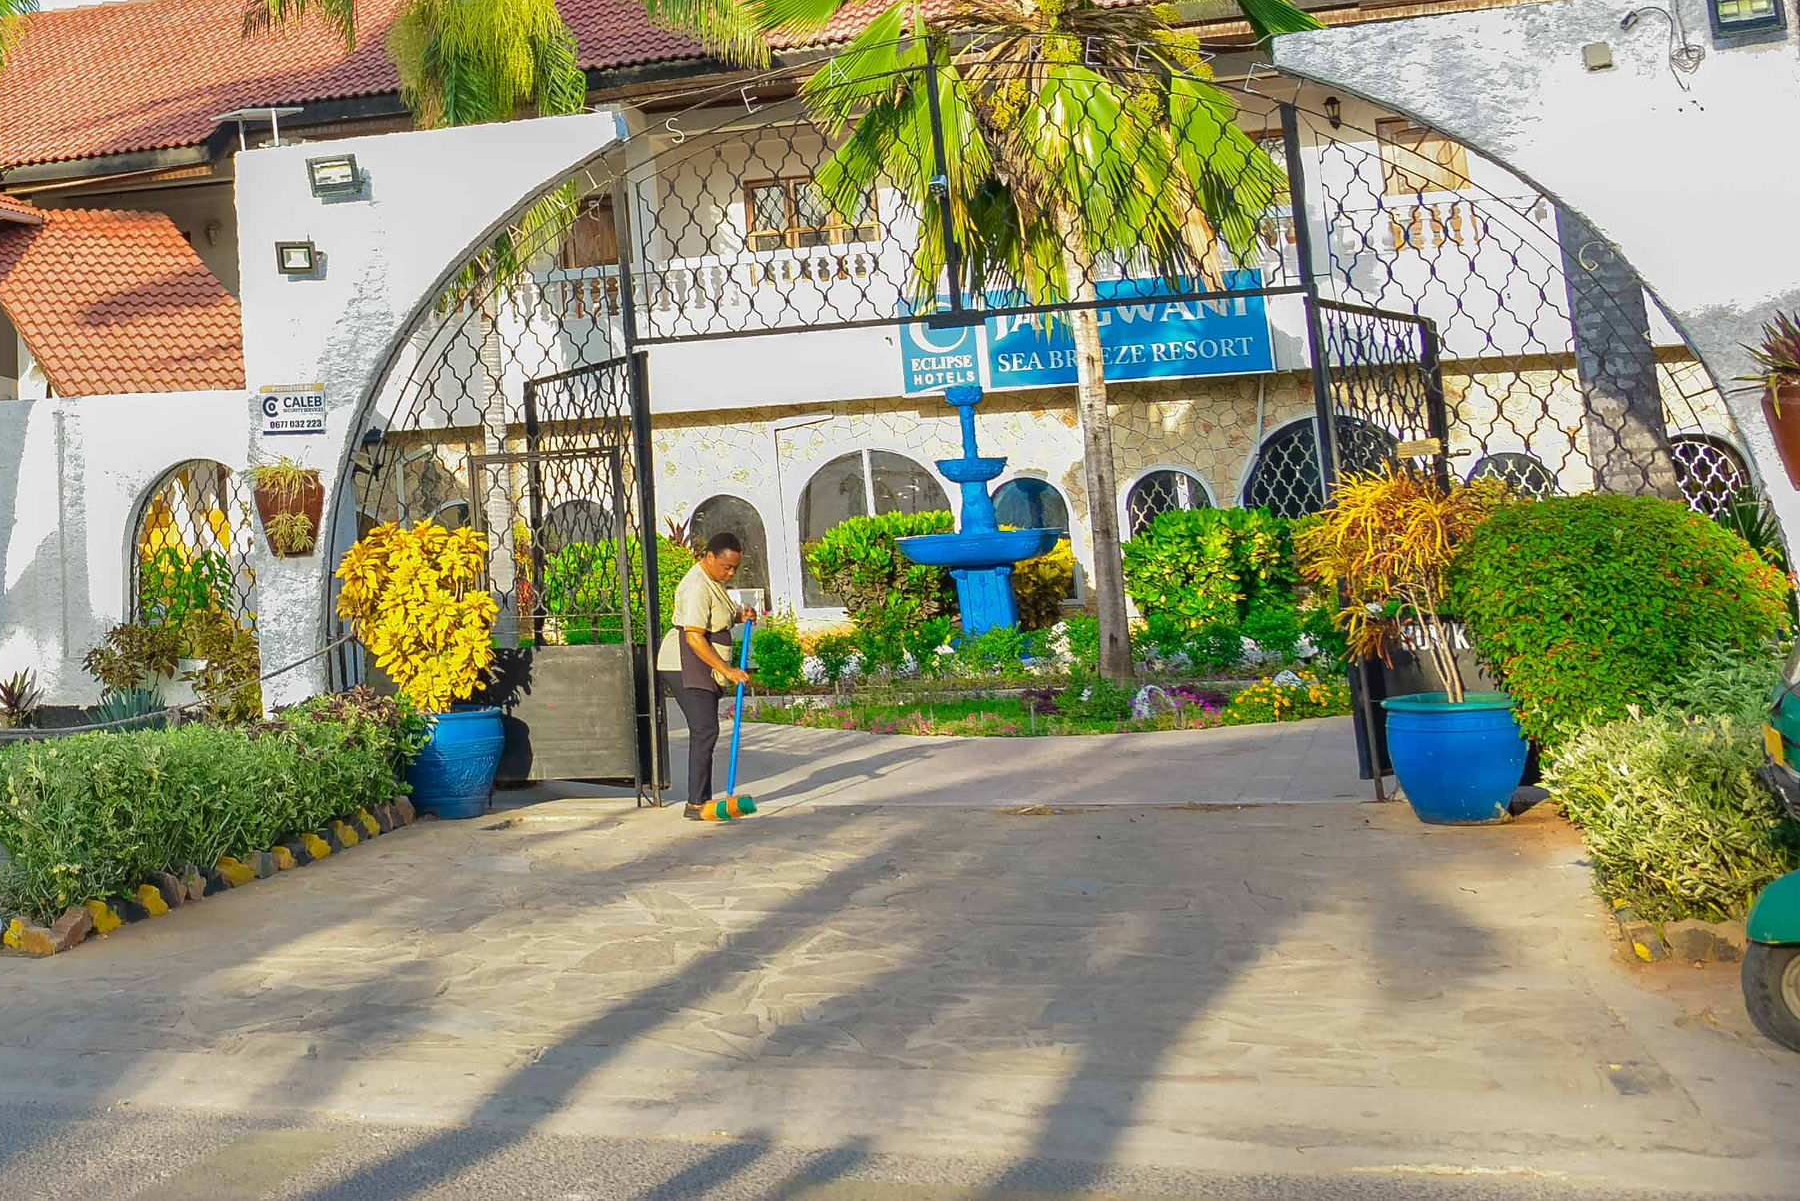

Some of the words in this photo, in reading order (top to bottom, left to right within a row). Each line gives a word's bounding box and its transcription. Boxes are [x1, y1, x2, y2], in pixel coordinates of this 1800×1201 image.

[910, 354, 973, 372] ECLIPSE
[997, 350, 1044, 373] SEA
[1048, 344, 1146, 369] BREZE
[1151, 336, 1253, 362] RESORT
[913, 370, 976, 386] HOTELS
[283, 396, 323, 408] CALEB
